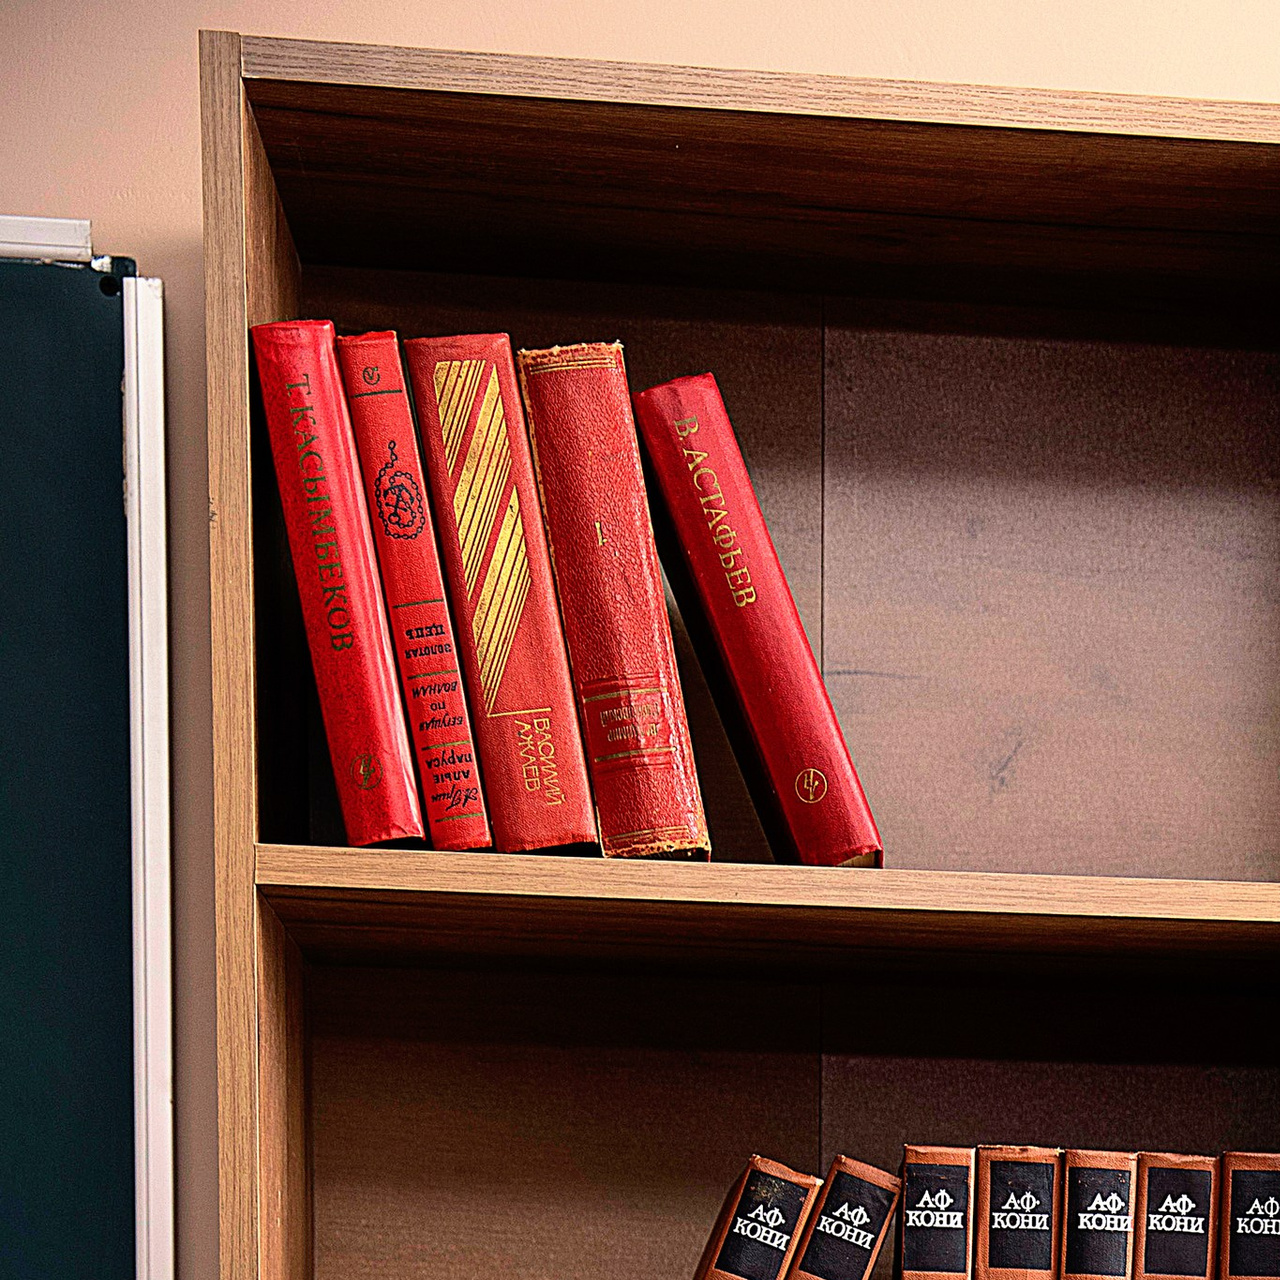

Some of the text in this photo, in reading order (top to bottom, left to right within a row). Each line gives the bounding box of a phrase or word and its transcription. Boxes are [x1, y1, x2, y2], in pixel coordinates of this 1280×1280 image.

[289, 404, 354, 652] КАСЫМБЕКОВ
[683, 448, 758, 609] АСТАФЬЕВ
[406, 623, 445, 640] ЦЕПЬ
[405, 643, 451, 659] ЗОЛОТАЯ
[412, 681, 457, 699] ВОЛНАМ
[430, 702, 445, 711] ПО
[419, 715, 463, 732] БЕГУЩАЯ
[426, 751, 472, 769] ПАРУСА
[515, 720, 541, 792] АЖАЕВ
[534, 718, 565, 806] ВАСИЛИЙ
[434, 769, 470, 784] АЛЫЕ
[906, 1210, 964, 1229] КОНИ
[992, 1212, 1049, 1231] КОНИ
[1078, 1213, 1133, 1231] КОНИ
[1148, 1214, 1205, 1234] КОНИ
[733, 1217, 790, 1251] КОНИ
[816, 1215, 875, 1249] КОНИ
